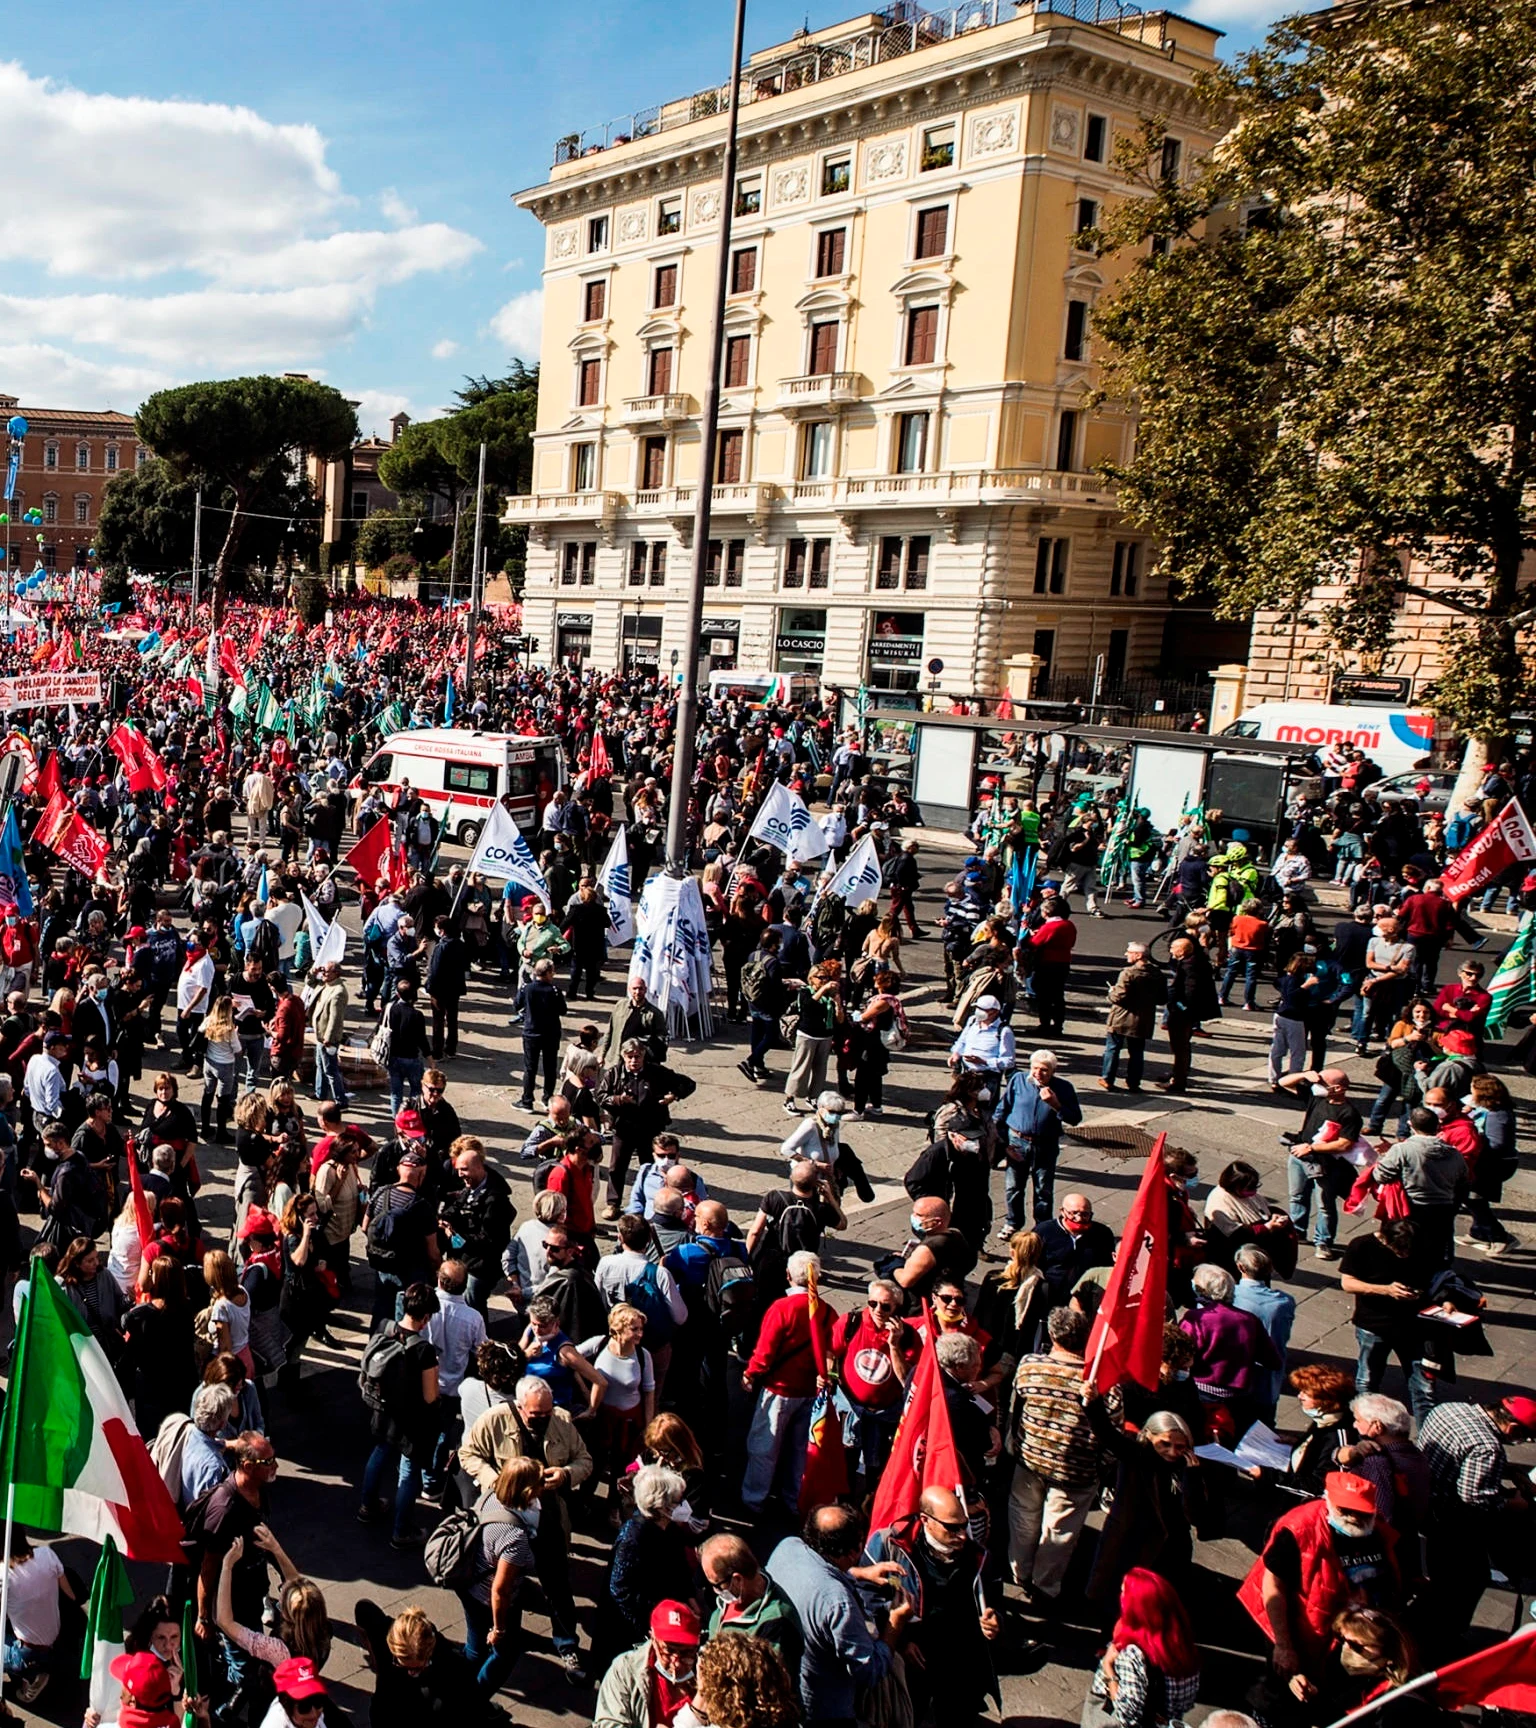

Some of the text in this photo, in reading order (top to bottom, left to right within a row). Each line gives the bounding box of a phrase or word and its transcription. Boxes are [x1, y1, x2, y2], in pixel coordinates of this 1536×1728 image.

[777, 639, 824, 650] LO CASCIO
[871, 641, 916, 651] ARREDAMENTI
[883, 649, 915, 657] MISURA
[17, 688, 41, 702] DELLE
[63, 686, 96, 698] POPOLARI
[1276, 725, 1381, 749] MORINI
[414, 744, 483, 758] CROCE ROSSA ITALIANA
